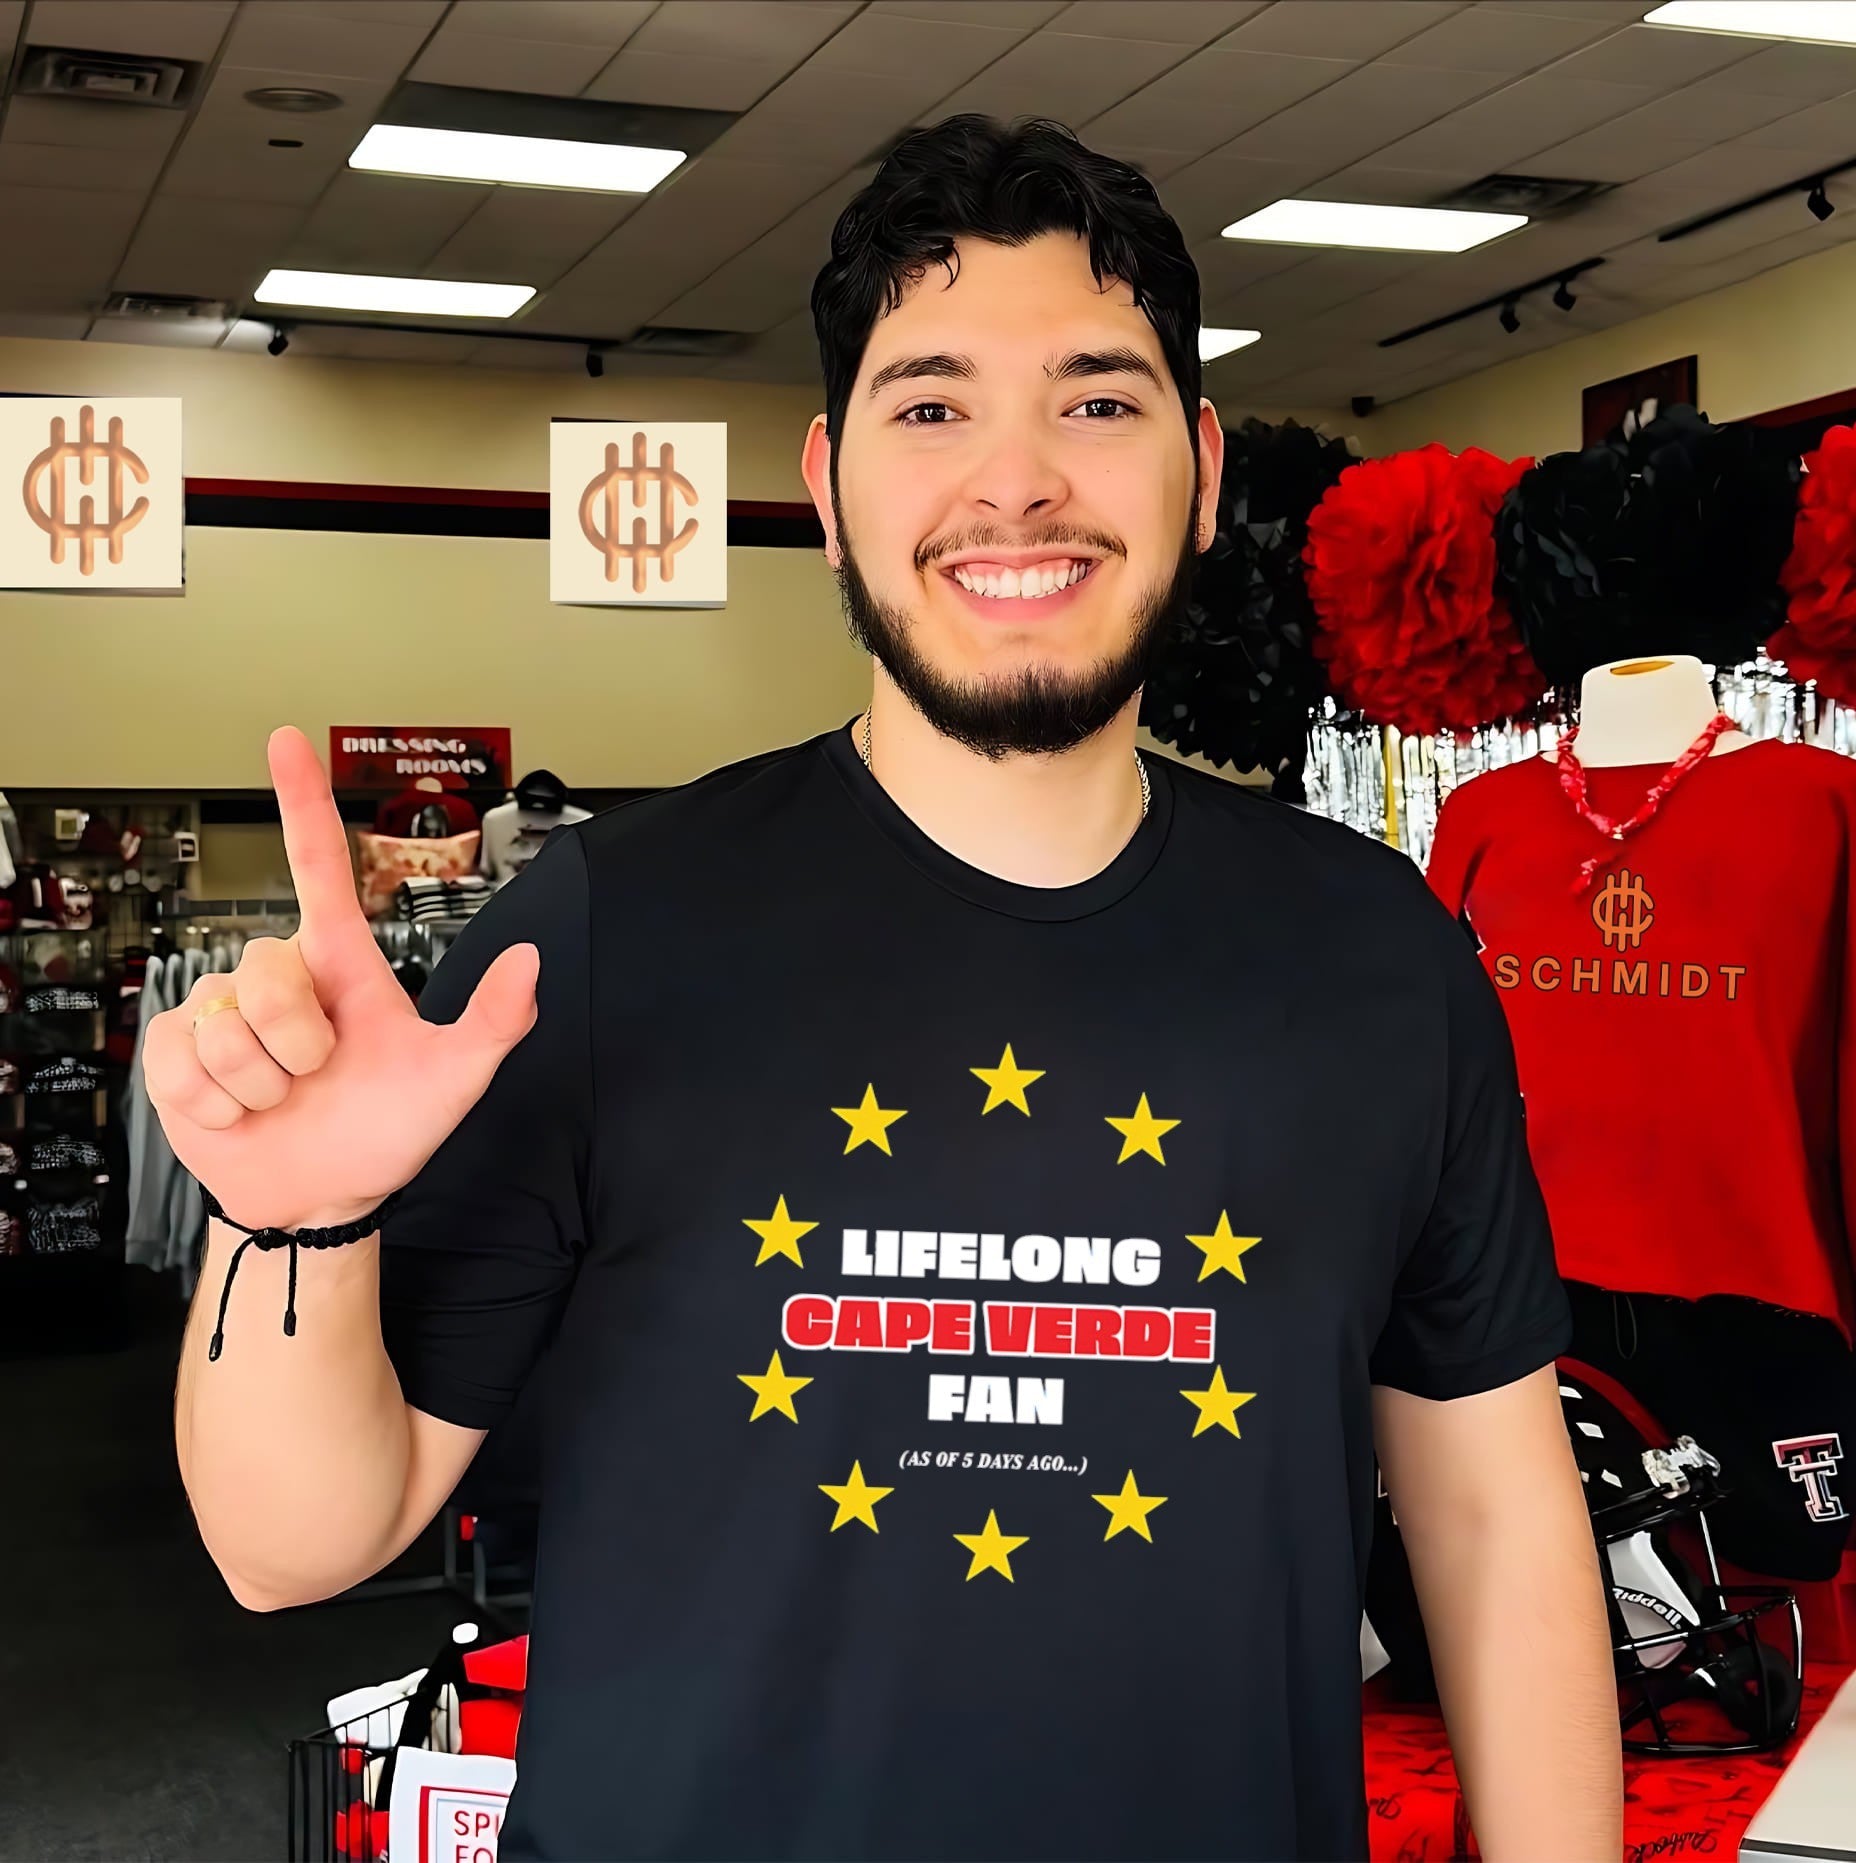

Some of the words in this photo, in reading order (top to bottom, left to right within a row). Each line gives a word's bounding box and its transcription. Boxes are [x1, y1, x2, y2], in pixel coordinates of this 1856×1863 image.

[342, 737, 466, 754] DRESSING
[396, 758, 487, 775] ROOMS
[1494, 953, 1747, 1001] SCHMIDT
[841, 1228, 1162, 1287] LIFELONG
[781, 1293, 976, 1355] CAPE
[982, 1301, 1216, 1363] VERDE
[927, 1374, 1065, 1426] FAN
[899, 1450, 932, 1470] (AS
[935, 1451, 960, 1469] OF
[961, 1452, 974, 1469] 5
[977, 1453, 1024, 1471] DAYS
[1026, 1454, 1089, 1476] AGO...)
